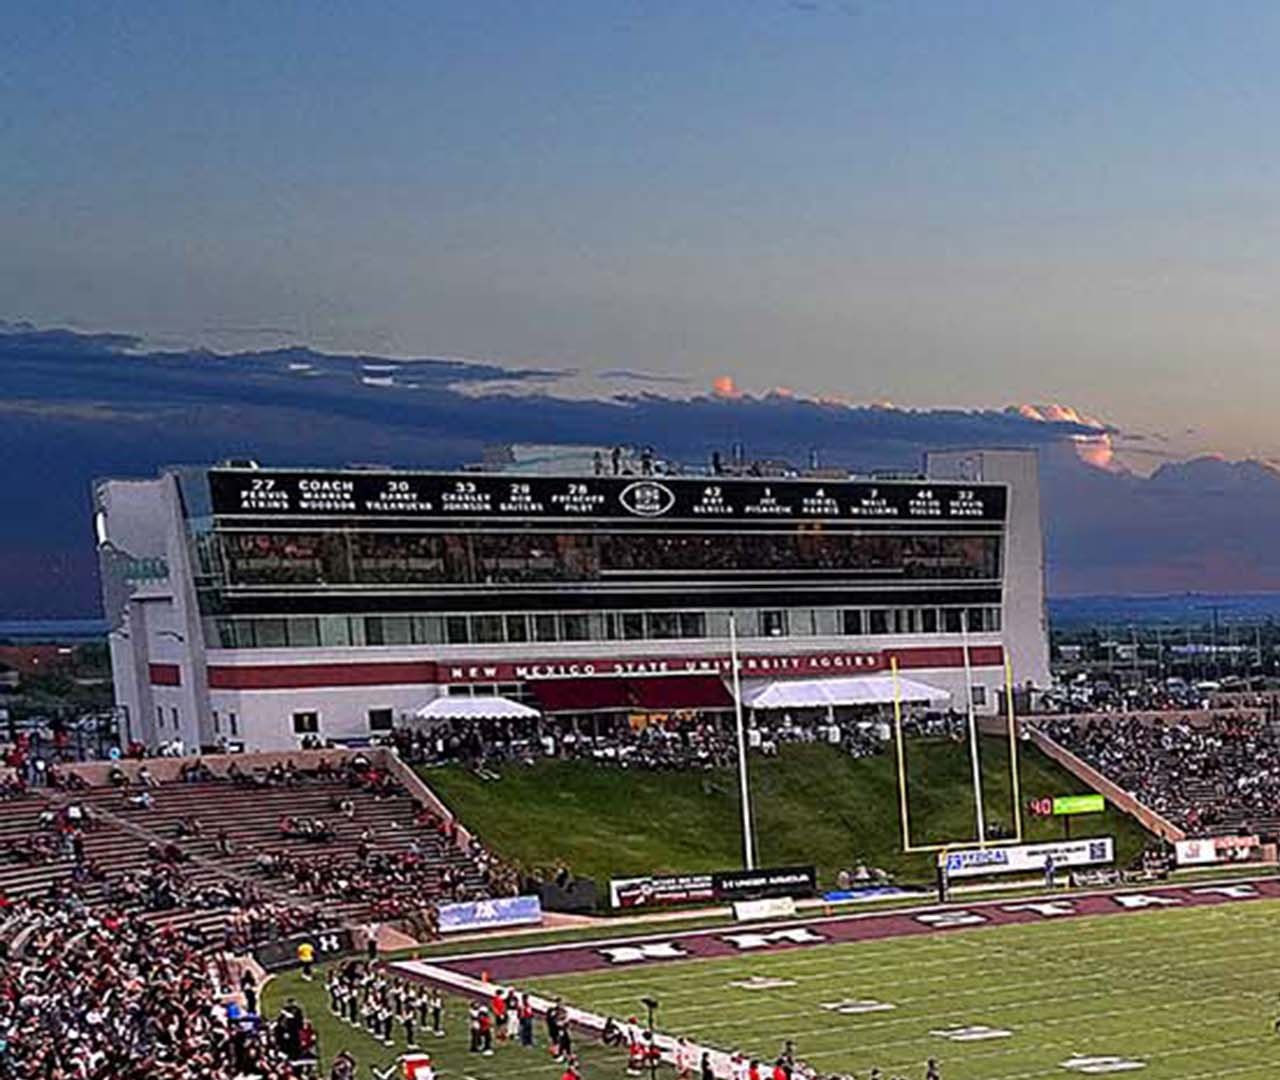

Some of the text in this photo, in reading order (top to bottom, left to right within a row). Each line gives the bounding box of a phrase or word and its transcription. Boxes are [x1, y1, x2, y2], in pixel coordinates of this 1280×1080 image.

[299, 480, 354, 491] COACH
[452, 667, 497, 678] NEW
[614, 662, 668, 674] STATE
[810, 655, 875, 668] AGGIES
